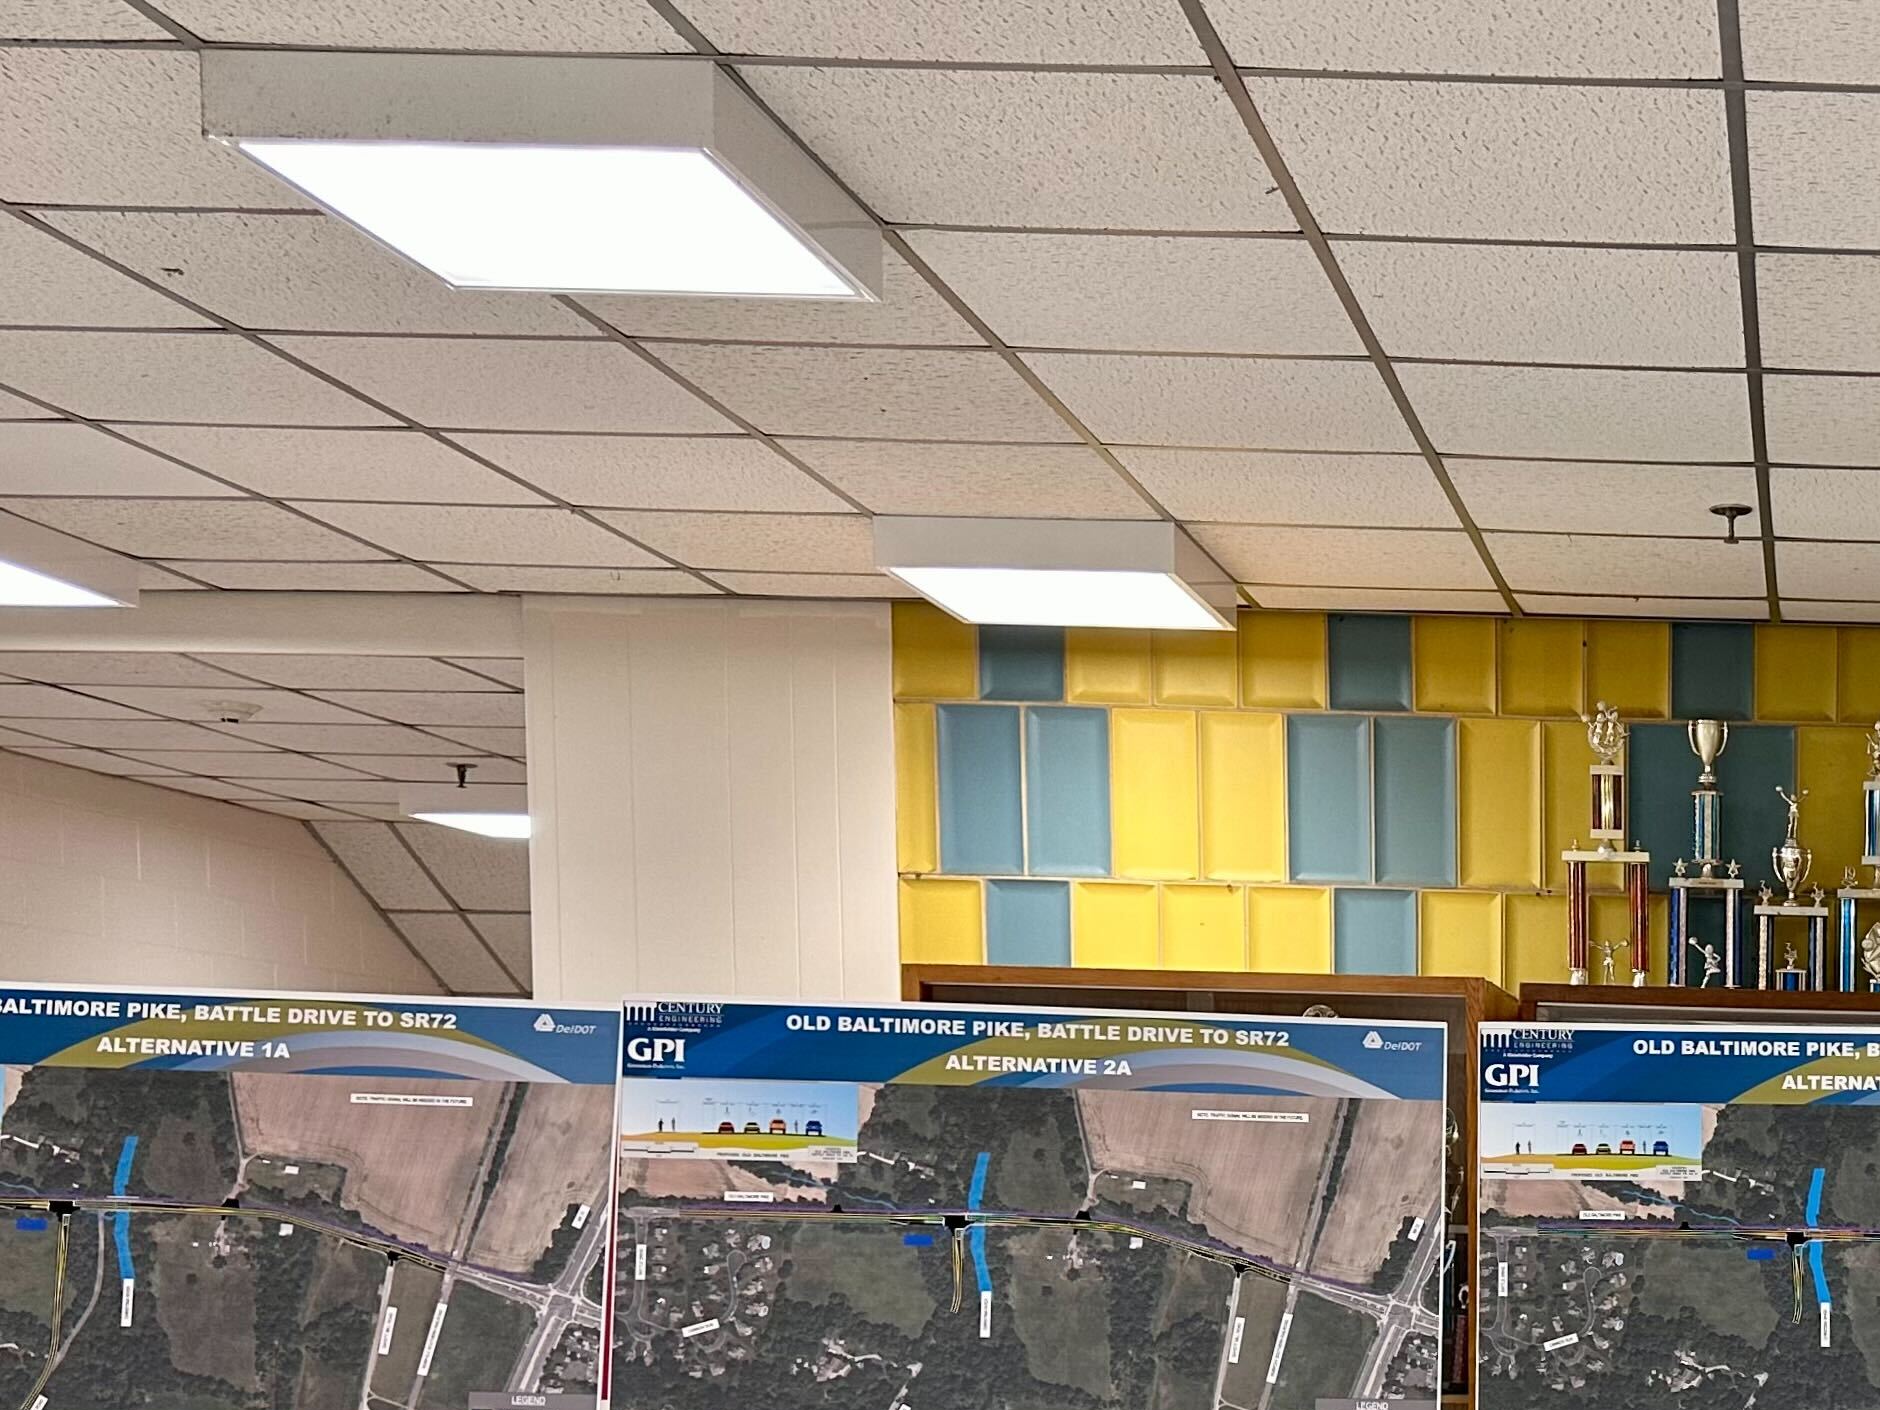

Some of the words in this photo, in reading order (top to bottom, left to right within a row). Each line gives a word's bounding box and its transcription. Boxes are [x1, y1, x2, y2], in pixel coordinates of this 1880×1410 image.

[0, 998, 120, 1018] ALTIMORE
[127, 1002, 187, 1023] PIKE,
[194, 1005, 280, 1023] BATTLE
[288, 1008, 356, 1026] DRIVE
[363, 1010, 393, 1027] TO
[400, 1012, 457, 1029] SR72
[658, 1002, 723, 1014] CENTURY
[659, 1015, 722, 1023] ENGINEERING
[786, 1015, 830, 1031] OLD
[838, 1017, 965, 1035] BALTIMORE
[973, 1021, 1031, 1040] PIKE,
[1038, 1023, 1120, 1040] BATTLE
[1127, 1027, 1192, 1043] DRIVE
[1199, 1028, 1228, 1044] TO
[1235, 1030, 1289, 1046] SR72
[1512, 1029, 1575, 1040] CENTURY
[96, 1037, 254, 1057] ALTERNATIVE
[261, 1042, 290, 1058] 1A
[627, 1037, 686, 1062] GPI
[1633, 1040, 1675, 1055] OLD
[1681, 1041, 1800, 1056] BALTIMORE
[1807, 1042, 1860, 1059] PIKE,
[946, 1055, 1097, 1075] ALTERNATIVE
[1103, 1060, 1132, 1076] 2A
[1485, 1063, 1540, 1087] GPI
[511, 1395, 546, 1406] LEGEND
